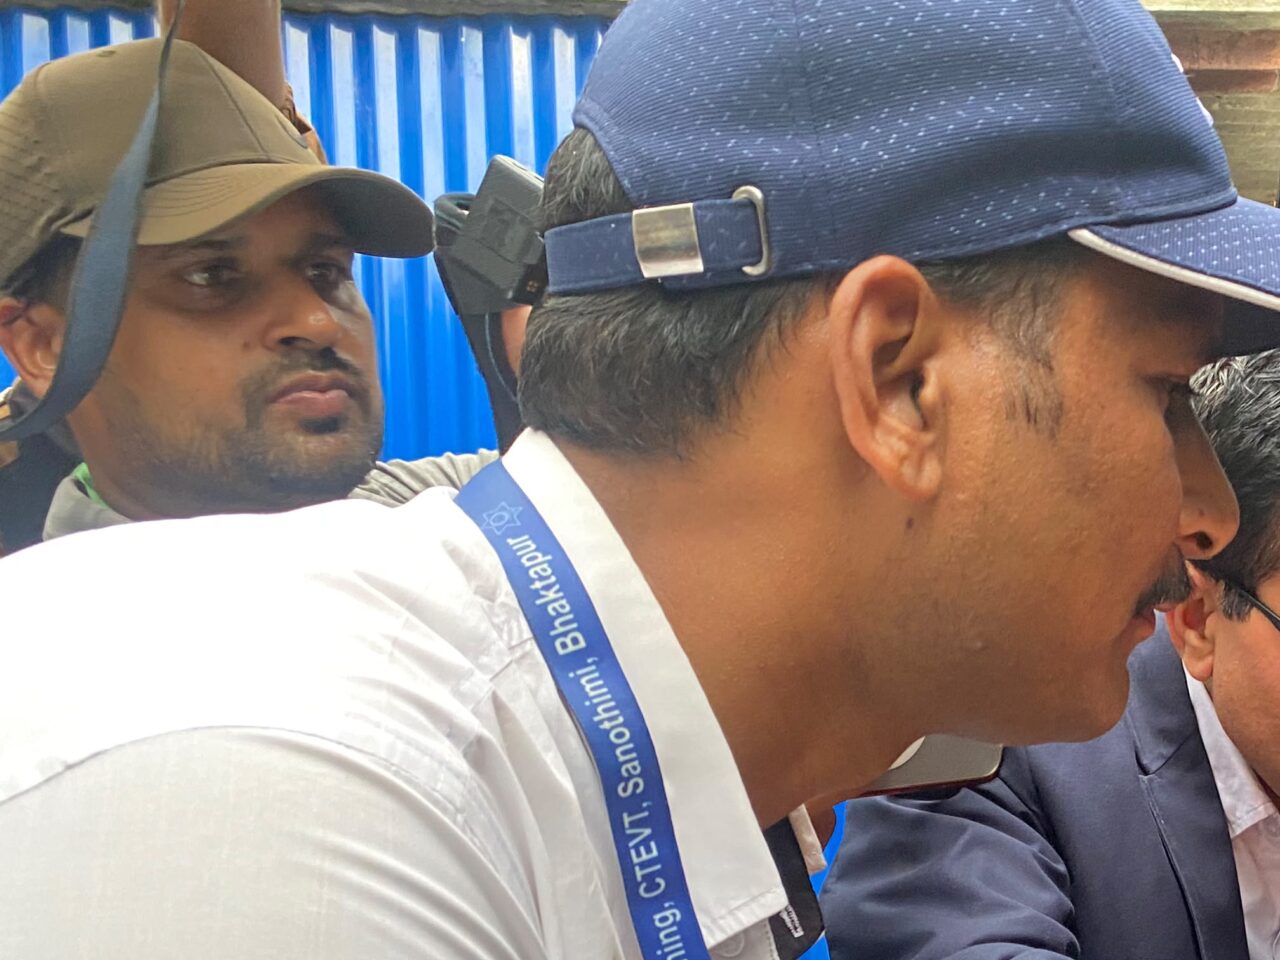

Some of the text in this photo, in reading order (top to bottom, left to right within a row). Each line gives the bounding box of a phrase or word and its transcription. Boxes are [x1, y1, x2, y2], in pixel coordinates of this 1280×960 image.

[506, 534, 587, 655] Bhaktapur
[568, 656, 645, 798] Sanothimi,
[622, 801, 666, 899] CTEVT,
